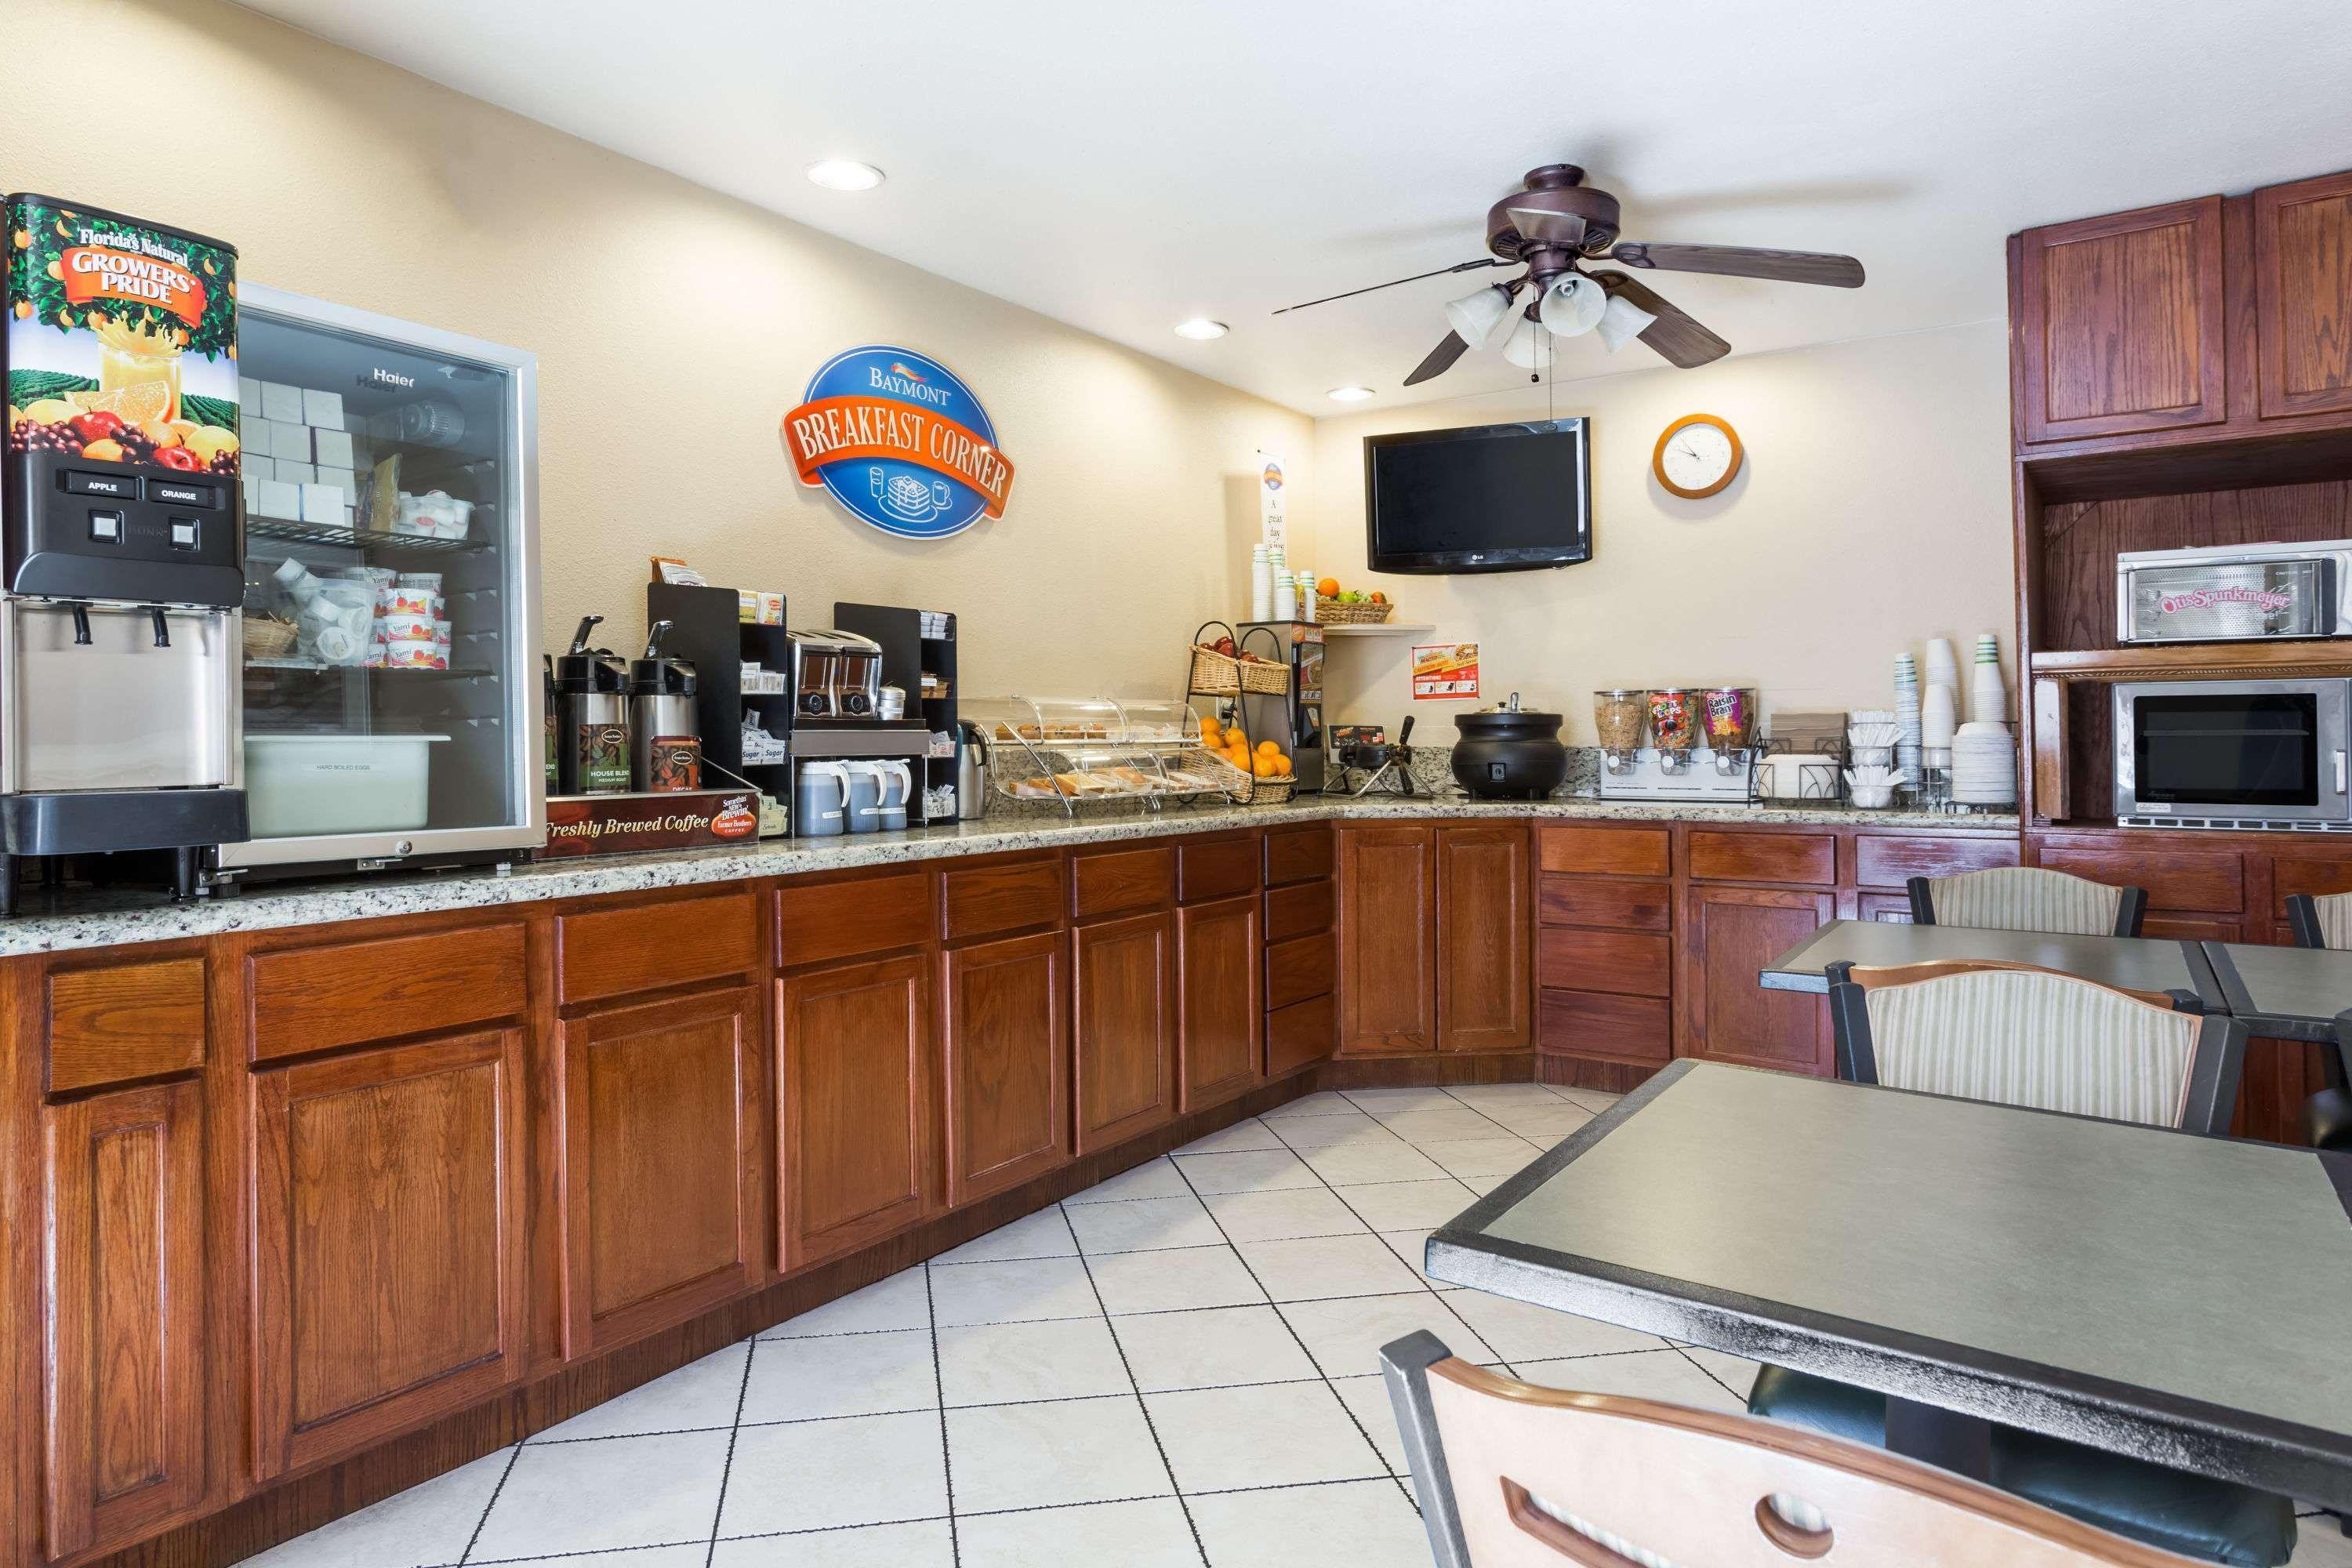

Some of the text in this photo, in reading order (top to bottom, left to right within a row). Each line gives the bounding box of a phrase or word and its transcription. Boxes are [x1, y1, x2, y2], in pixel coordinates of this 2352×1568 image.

[80, 228, 188, 267] Florida's Natural
[72, 251, 196, 293] GROWERS'
[101, 272, 172, 304] PRIDE
[373, 368, 414, 387] Haier
[869, 366, 951, 406] BAYMONT
[793, 406, 1006, 499] BREAKFAST CORNER
[88, 481, 117, 492] APPLE
[162, 489, 196, 500] ORANGE
[2194, 586, 2291, 611] Spunkmeyer
[395, 648, 412, 659] Yami
[1708, 695, 1735, 708] Raisin
[1711, 706, 1731, 717] Bran
[765, 749, 782, 758] Sugar
[721, 805, 749, 821] Brewin'
[546, 814, 710, 838] Freshly Brewed Coffee
